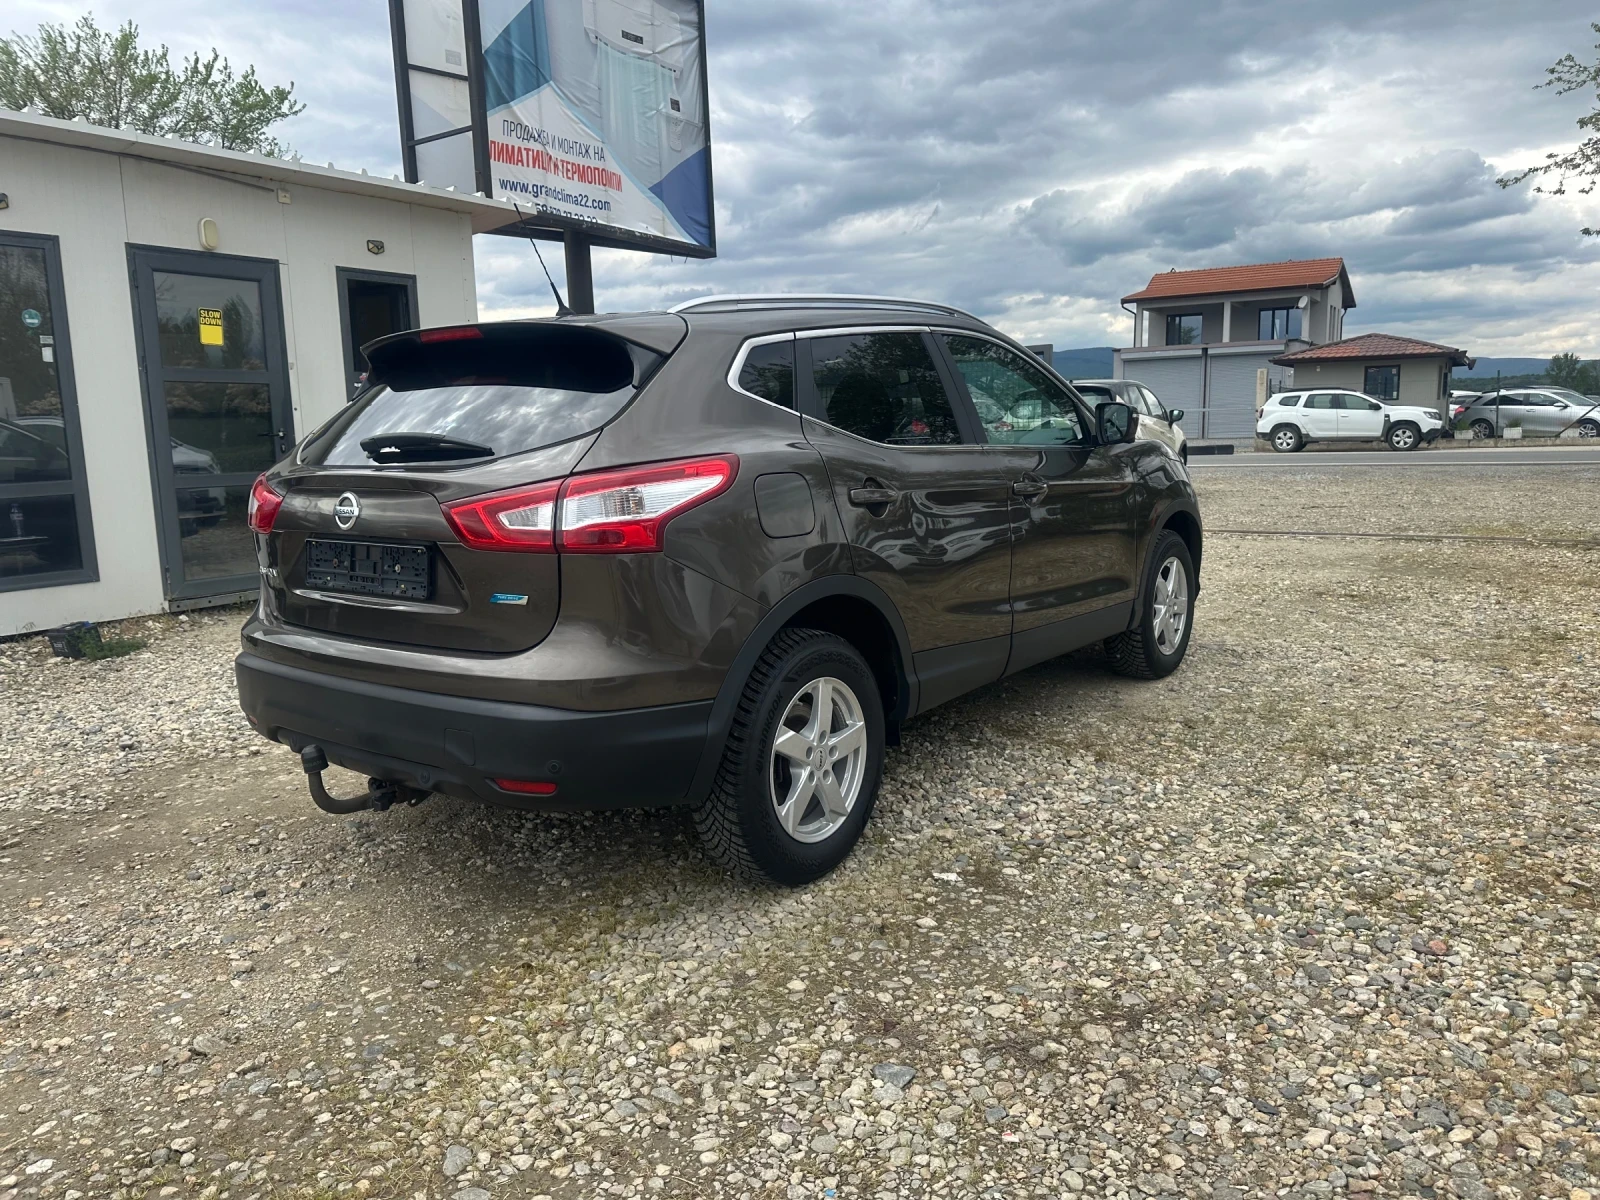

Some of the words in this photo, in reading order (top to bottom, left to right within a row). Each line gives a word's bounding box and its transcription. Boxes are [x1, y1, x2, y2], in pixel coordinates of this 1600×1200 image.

[503, 119, 550, 148] ПРОДАЖБА
[558, 136, 592, 160] МОНТАЖ
[593, 145, 606, 162] НА
[560, 158, 623, 193] ТЕРМОПОМПИ
[498, 178, 612, 212] www.grandclima22.com
[200, 310, 221, 318] SLOW
[200, 317, 222, 325] DOWN
